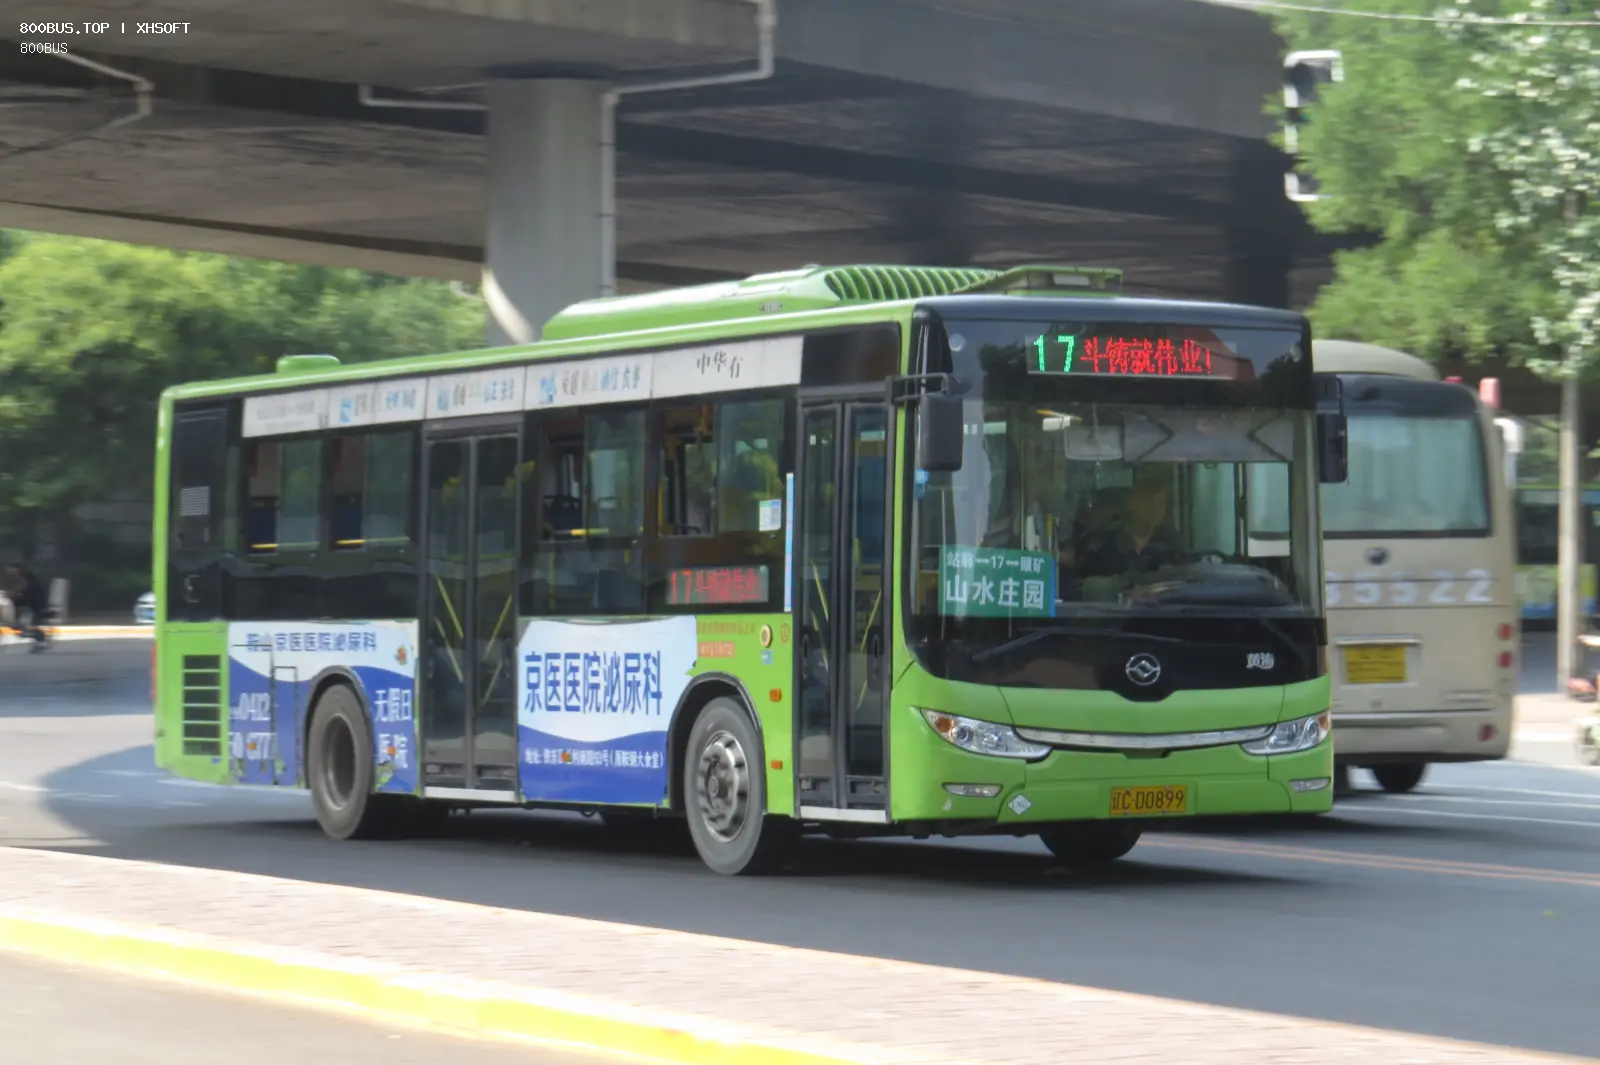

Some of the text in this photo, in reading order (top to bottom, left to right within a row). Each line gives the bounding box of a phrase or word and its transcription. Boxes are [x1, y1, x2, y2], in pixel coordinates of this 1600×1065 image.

[1033, 334, 1075, 372] 17
[946, 573, 1045, 610] 山水庄园
[524, 650, 662, 715] 京医医院泌尿科
